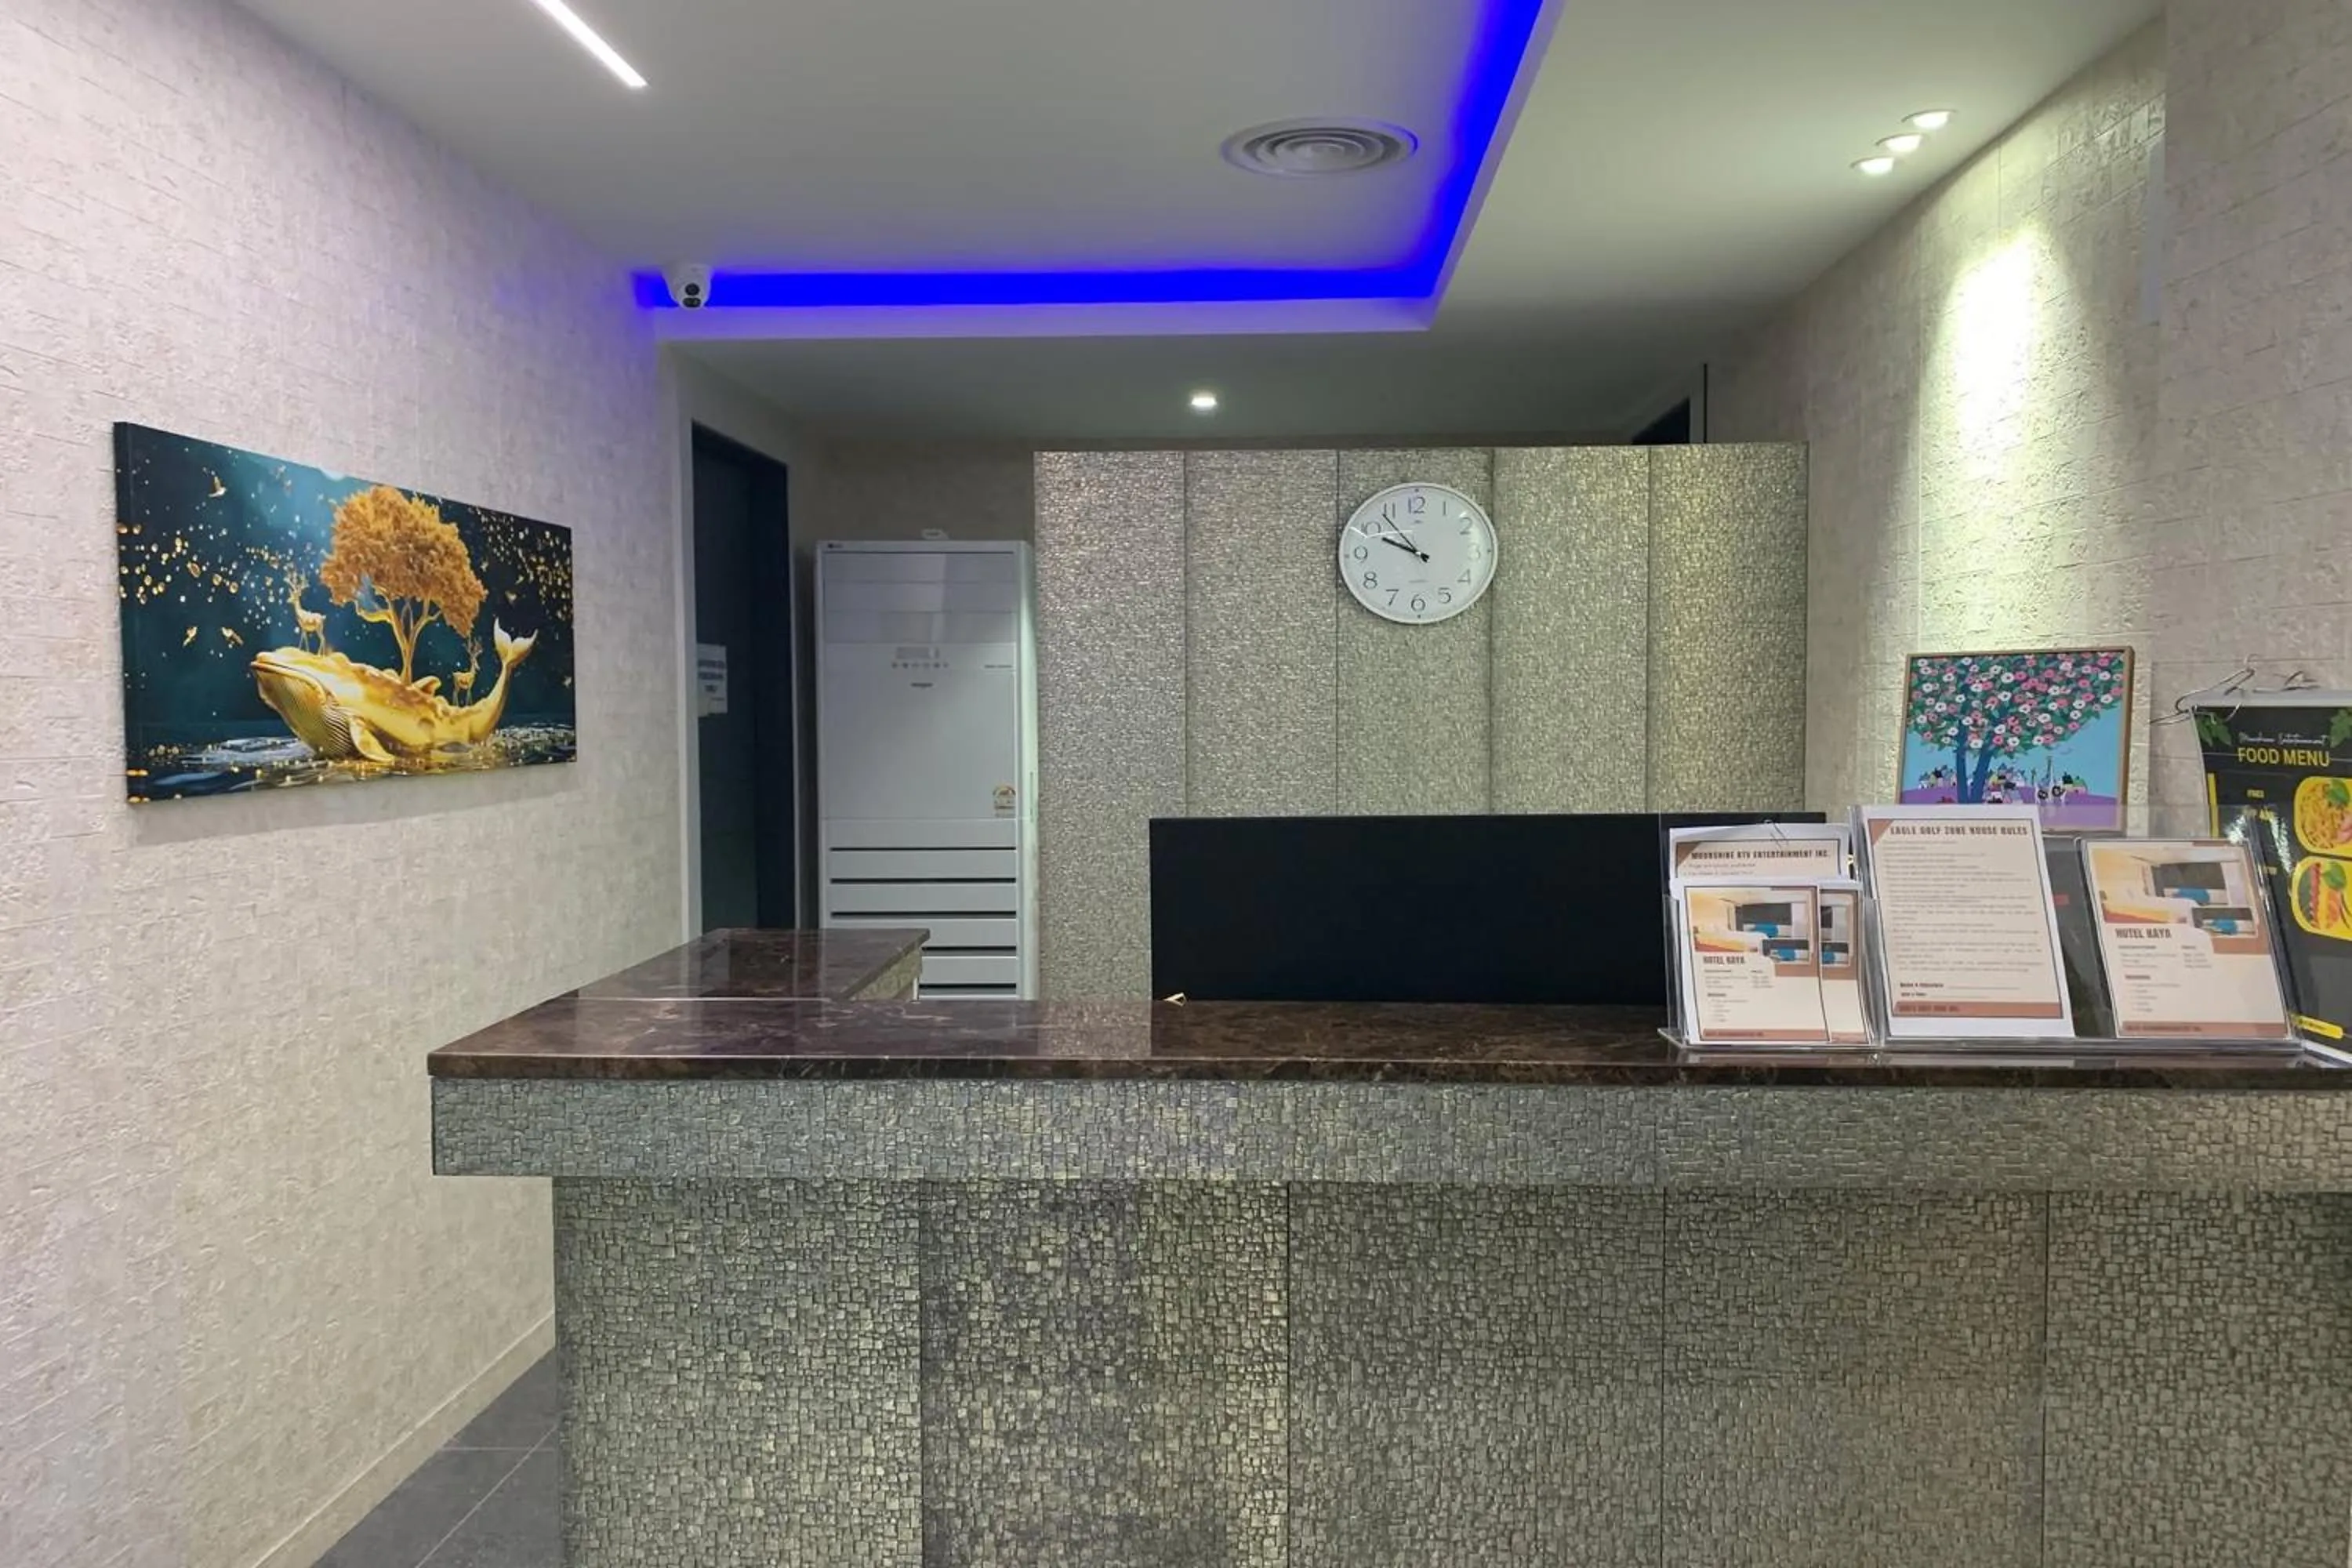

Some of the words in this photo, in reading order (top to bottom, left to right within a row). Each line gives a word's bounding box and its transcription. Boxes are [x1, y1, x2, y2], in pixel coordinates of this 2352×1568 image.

[1383, 503, 1396, 518] 11
[1408, 496, 1425, 514] 12
[1459, 517, 1472, 535] 2
[1354, 546, 1368, 563] 9
[1468, 543, 1481, 561] 3
[1363, 571, 1377, 589] 8
[1457, 569, 1472, 584] 4
[1386, 589, 1399, 606] 7
[1411, 593, 1426, 612] 6
[1438, 587, 1451, 604] 5
[2238, 747, 2279, 764] FOOD
[2283, 749, 2330, 767] MENU
[1753, 849, 1812, 859] ENTERTAINMENT
